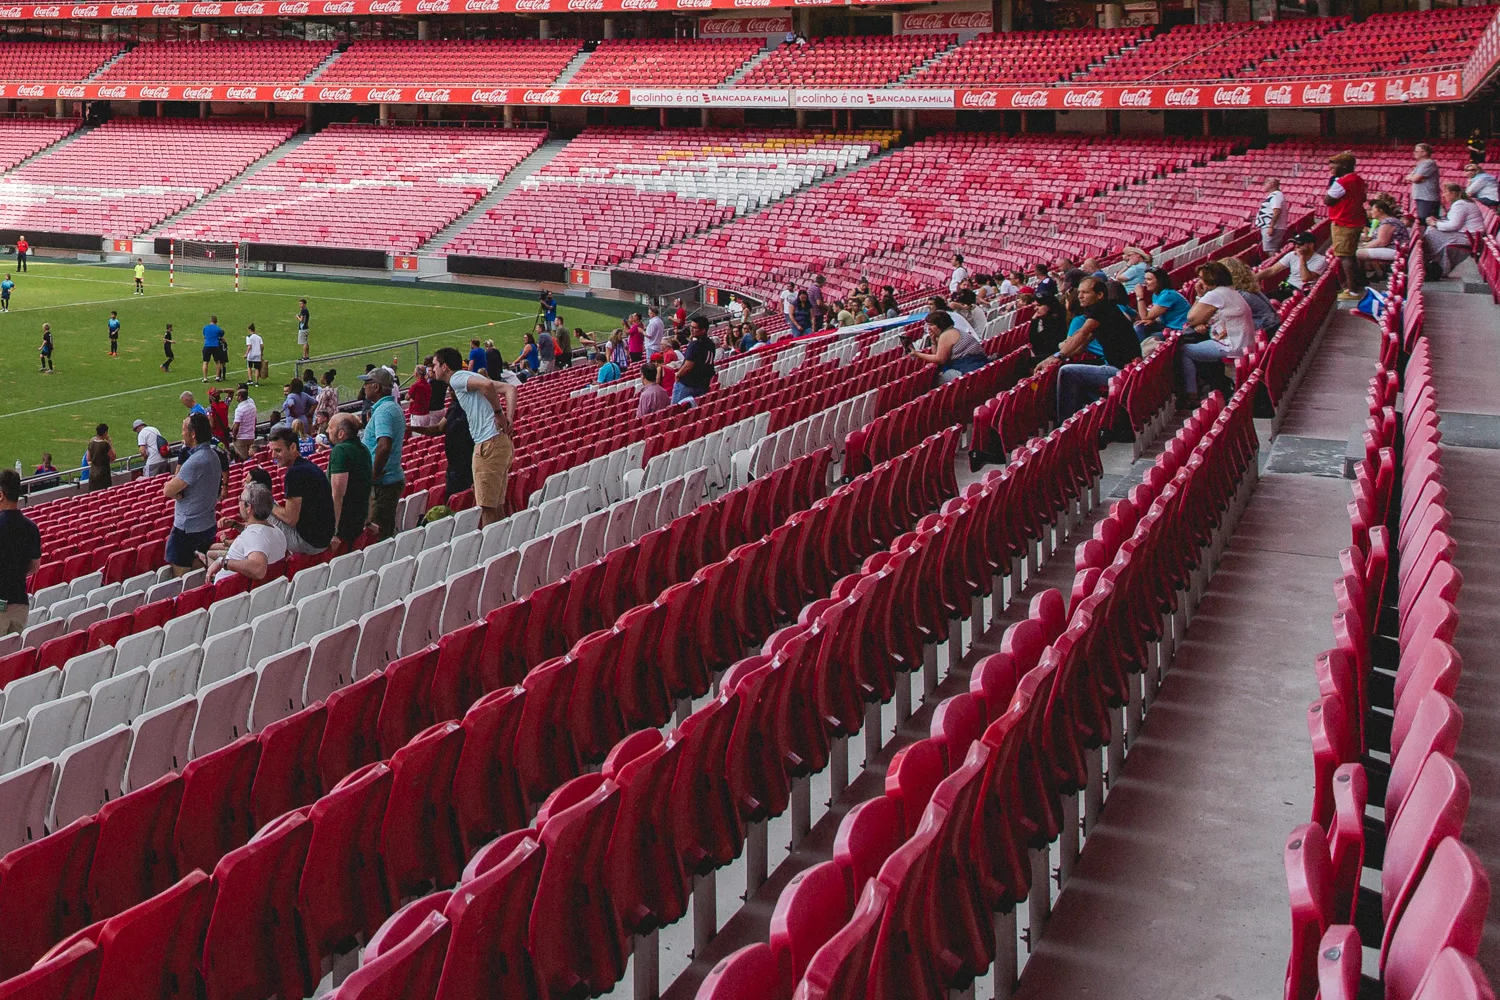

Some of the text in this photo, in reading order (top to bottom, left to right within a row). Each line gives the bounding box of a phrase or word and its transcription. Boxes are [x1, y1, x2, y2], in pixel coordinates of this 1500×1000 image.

[676, 92, 682, 102] é
[686, 94, 699, 102] na
[842, 92, 847, 102] é
